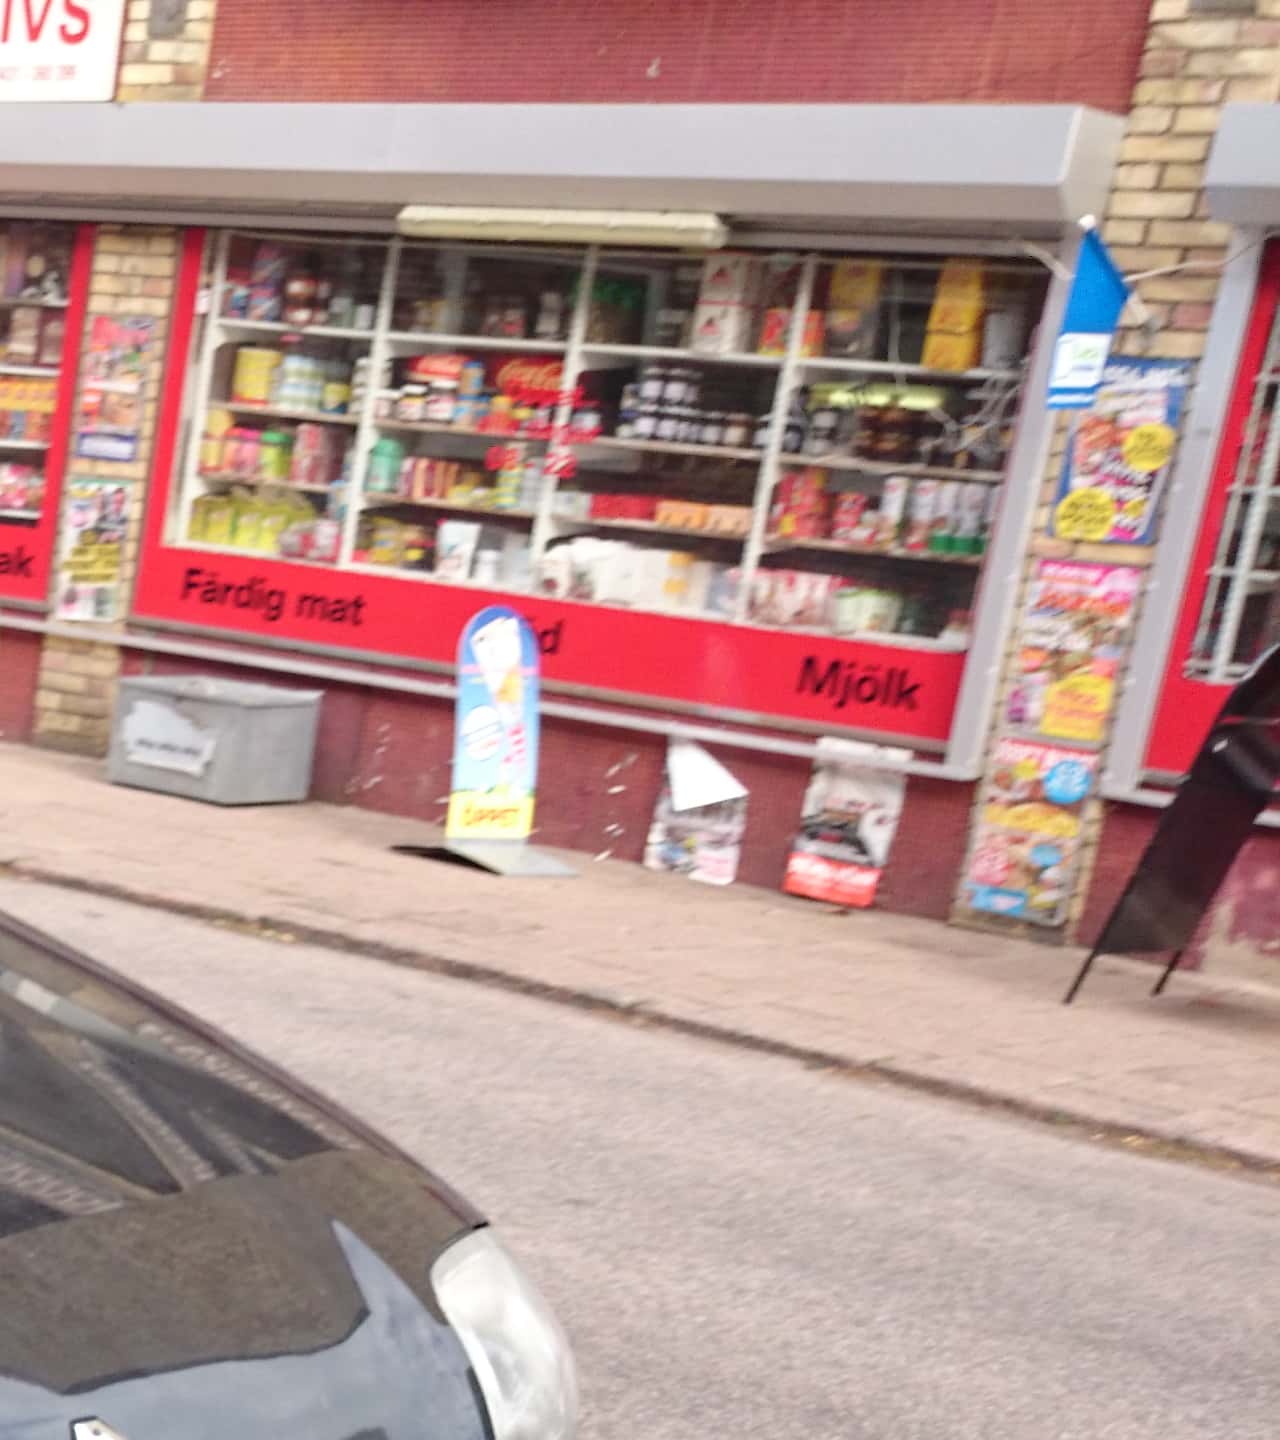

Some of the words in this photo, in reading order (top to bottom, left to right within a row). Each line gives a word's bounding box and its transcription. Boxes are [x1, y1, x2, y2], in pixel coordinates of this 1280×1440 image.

[180, 567, 285, 622] Färdig
[295, 594, 366, 626] mat
[795, 655, 922, 711] Mjölk
